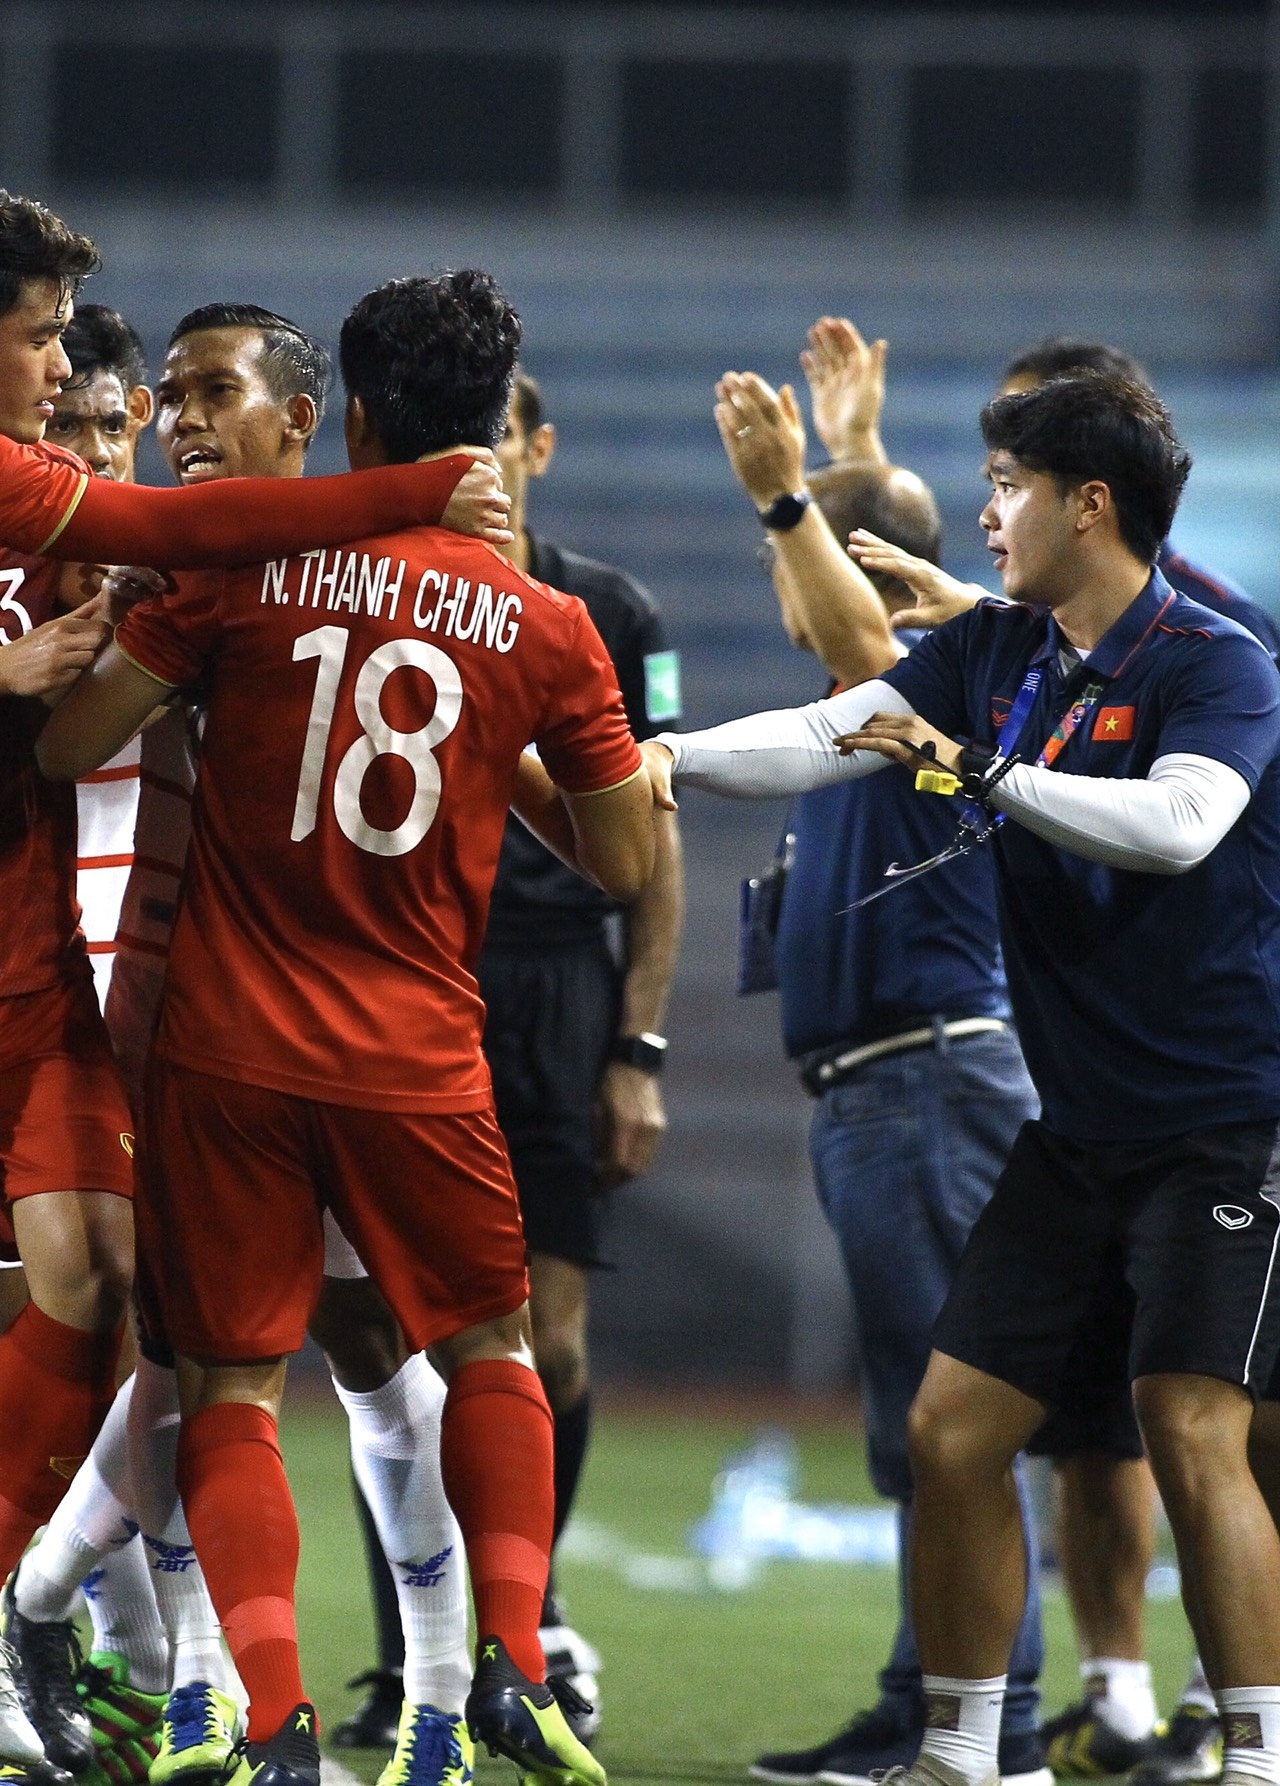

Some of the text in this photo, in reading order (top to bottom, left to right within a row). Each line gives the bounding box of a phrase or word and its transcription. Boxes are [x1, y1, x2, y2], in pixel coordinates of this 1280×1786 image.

[297, 549, 407, 621] THANH
[413, 569, 522, 653] CHUNG
[1022, 672, 1040, 693] ONE
[291, 625, 463, 856] 18
